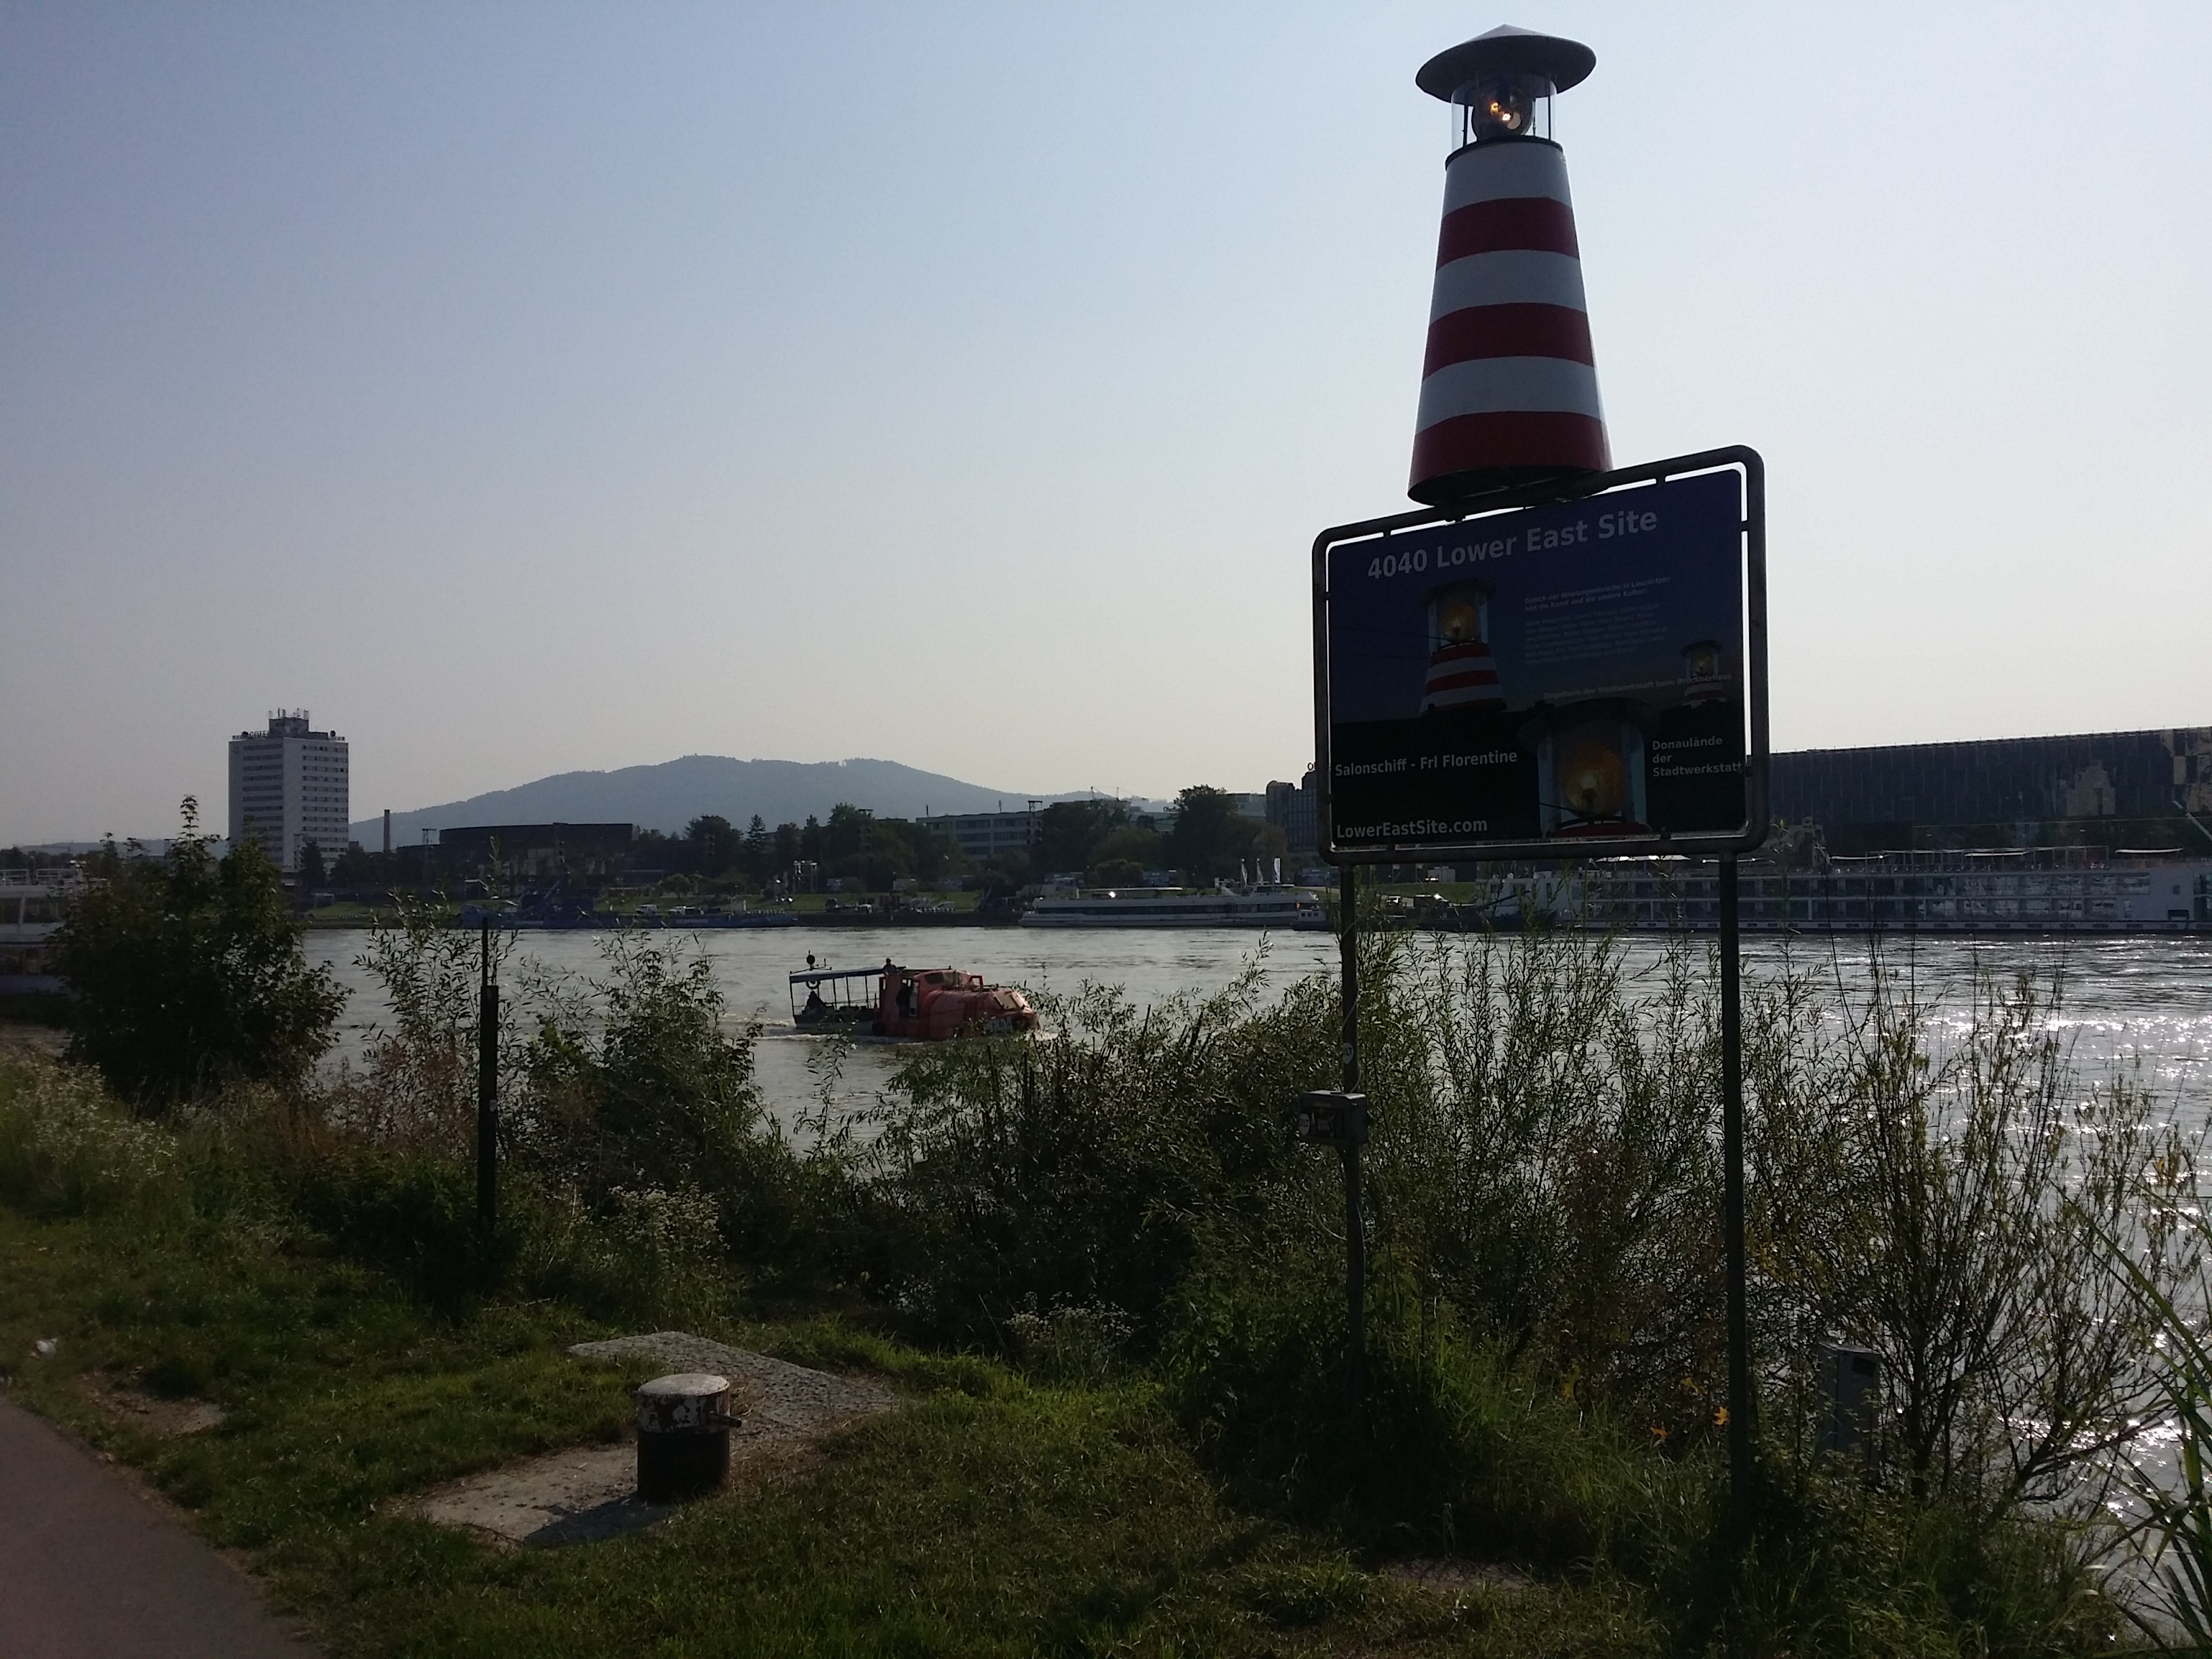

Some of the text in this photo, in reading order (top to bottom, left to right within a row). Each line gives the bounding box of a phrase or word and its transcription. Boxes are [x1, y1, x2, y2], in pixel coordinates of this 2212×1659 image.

[1368, 510, 1658, 579] 4040 Lower East Site
[1597, 681, 1654, 694] Stadtwerkstatt
[1652, 736, 1723, 750] Donaulände
[1334, 758, 1408, 777] Salonschiff
[1420, 755, 1437, 770] Frl
[1443, 750, 1518, 768] Florentine
[1652, 754, 1673, 764] der
[1652, 762, 1742, 777] Stadtwerkstatt
[1336, 819, 1488, 839] LowerEastSite.com
